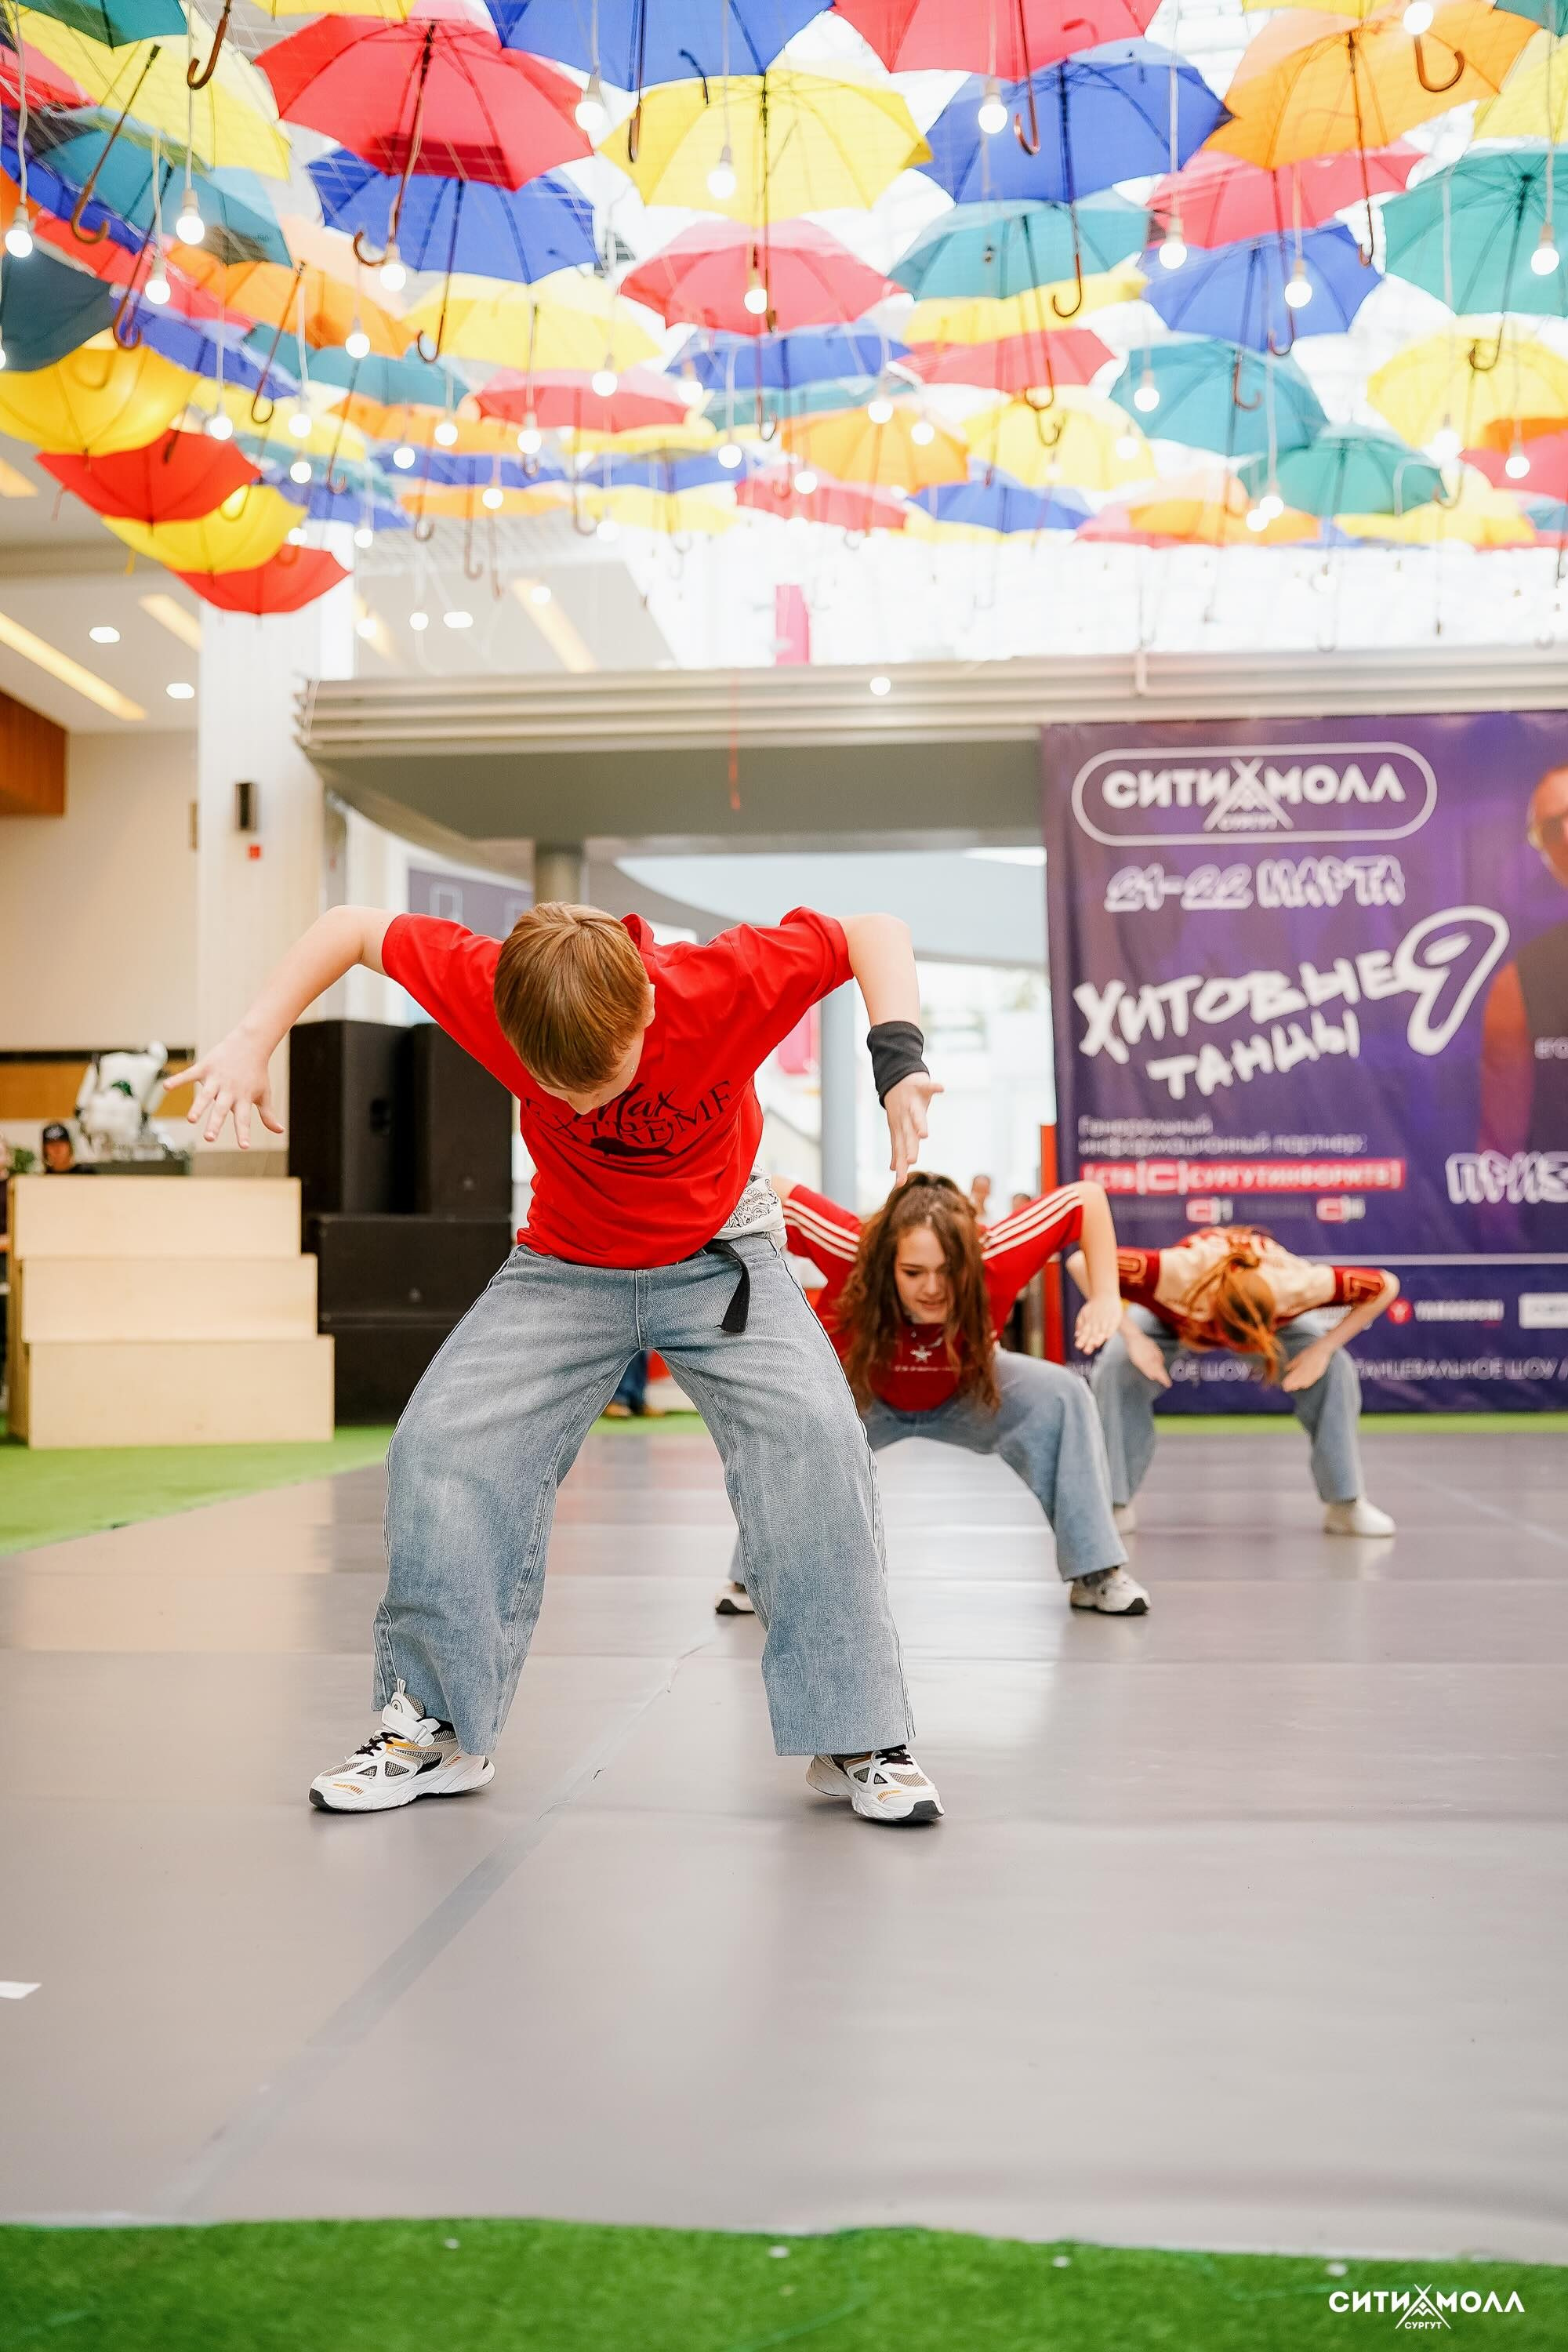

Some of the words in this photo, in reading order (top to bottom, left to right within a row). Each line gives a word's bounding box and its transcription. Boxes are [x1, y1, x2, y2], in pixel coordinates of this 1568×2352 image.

[1104, 863, 1254, 913] 21-22
[1073, 949, 1402, 1065] ХИТОВЫЕ
[1147, 1009, 1361, 1099] ТАНЦЫ
